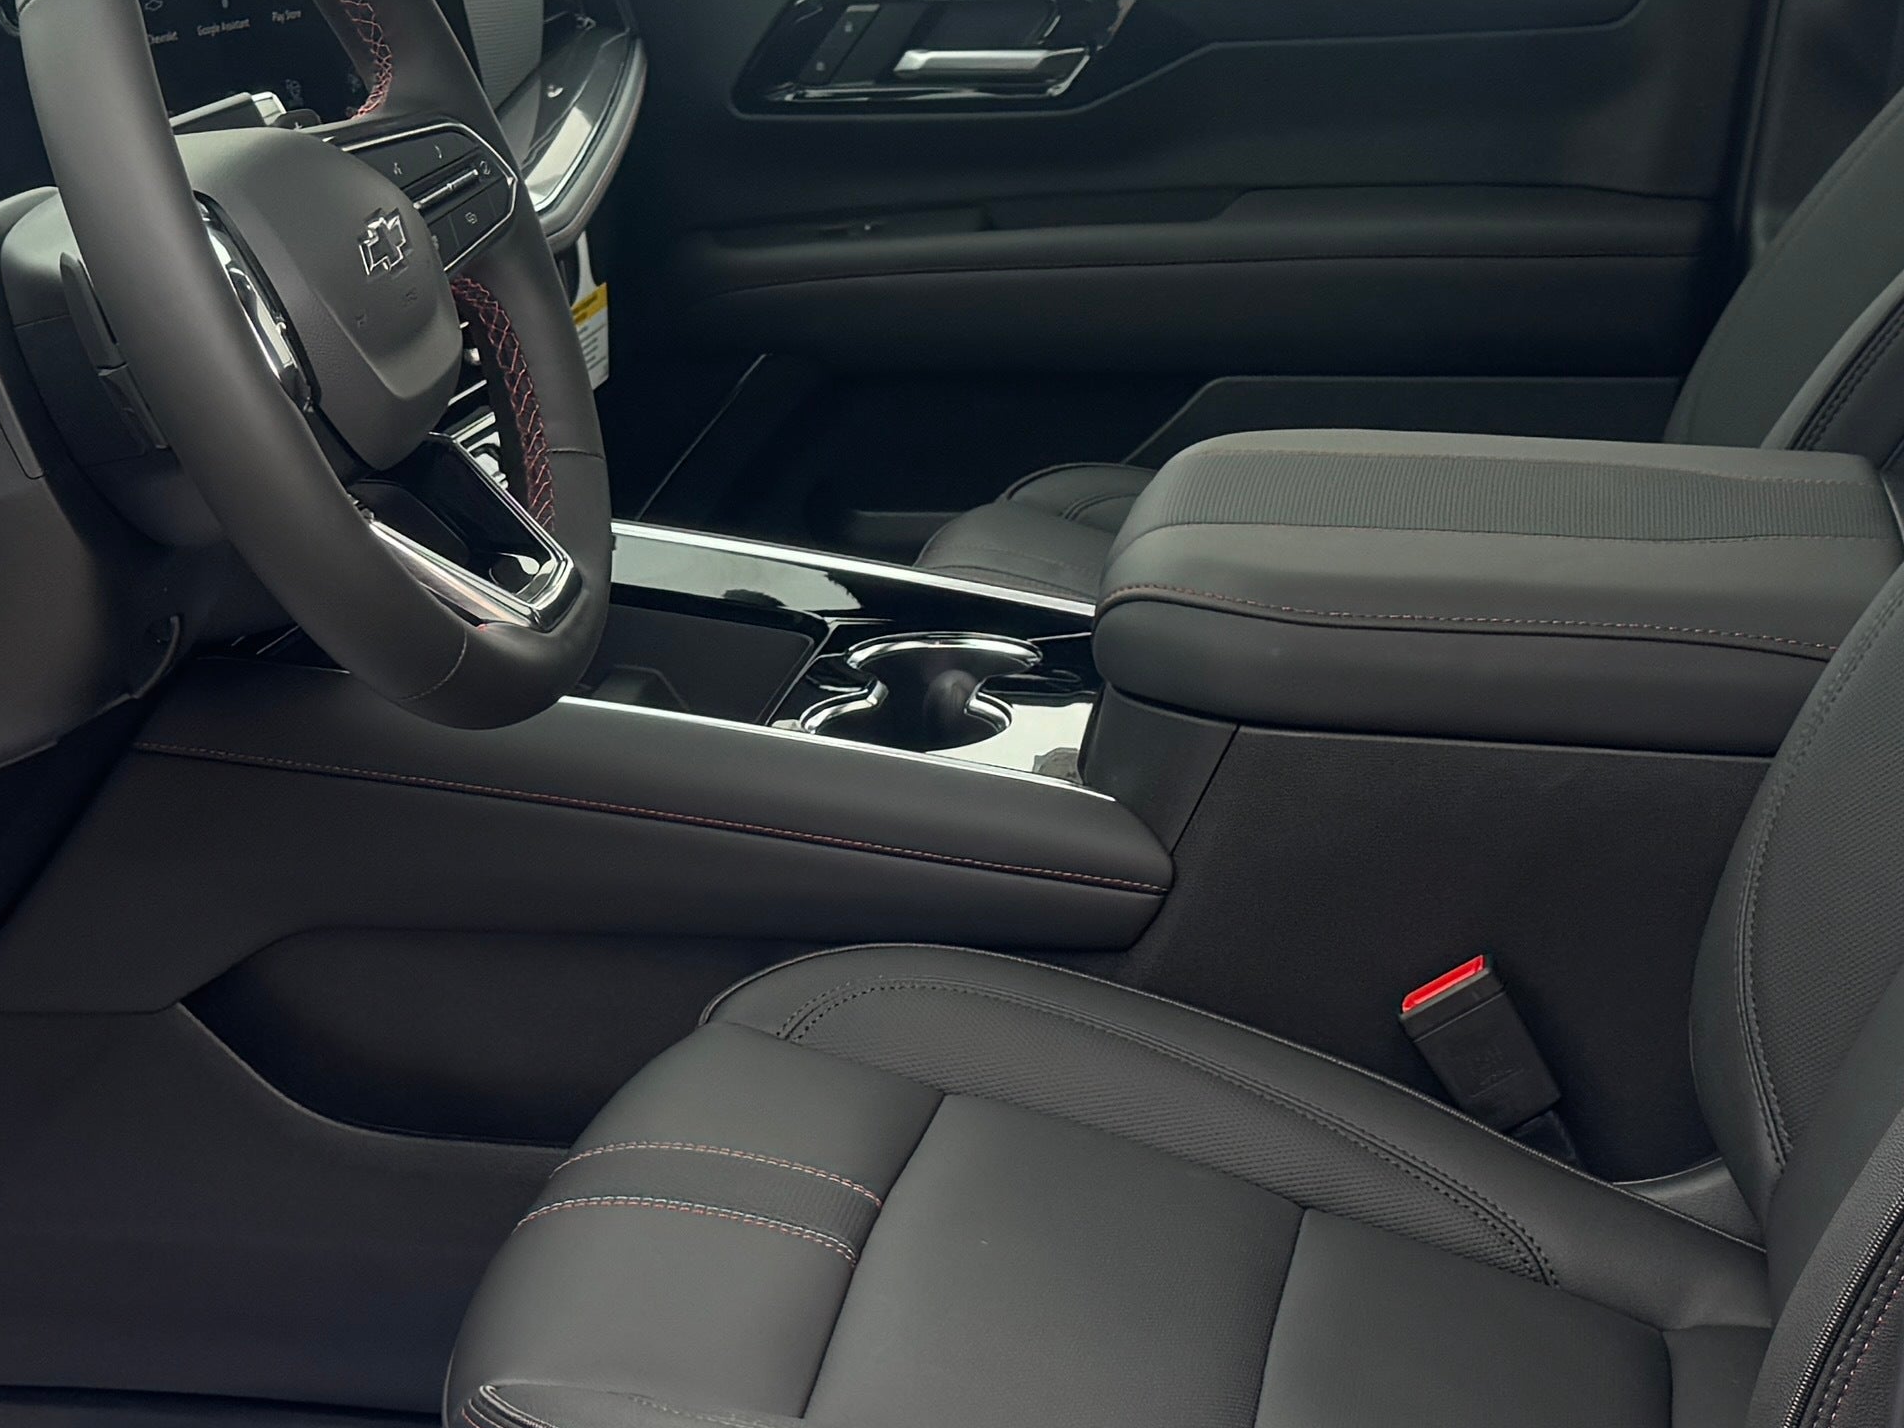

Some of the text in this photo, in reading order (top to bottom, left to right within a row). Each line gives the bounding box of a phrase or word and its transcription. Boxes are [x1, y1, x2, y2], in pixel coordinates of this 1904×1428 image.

[271, 8, 302, 24] Play Store
[197, 18, 251, 38] Google Assistant
